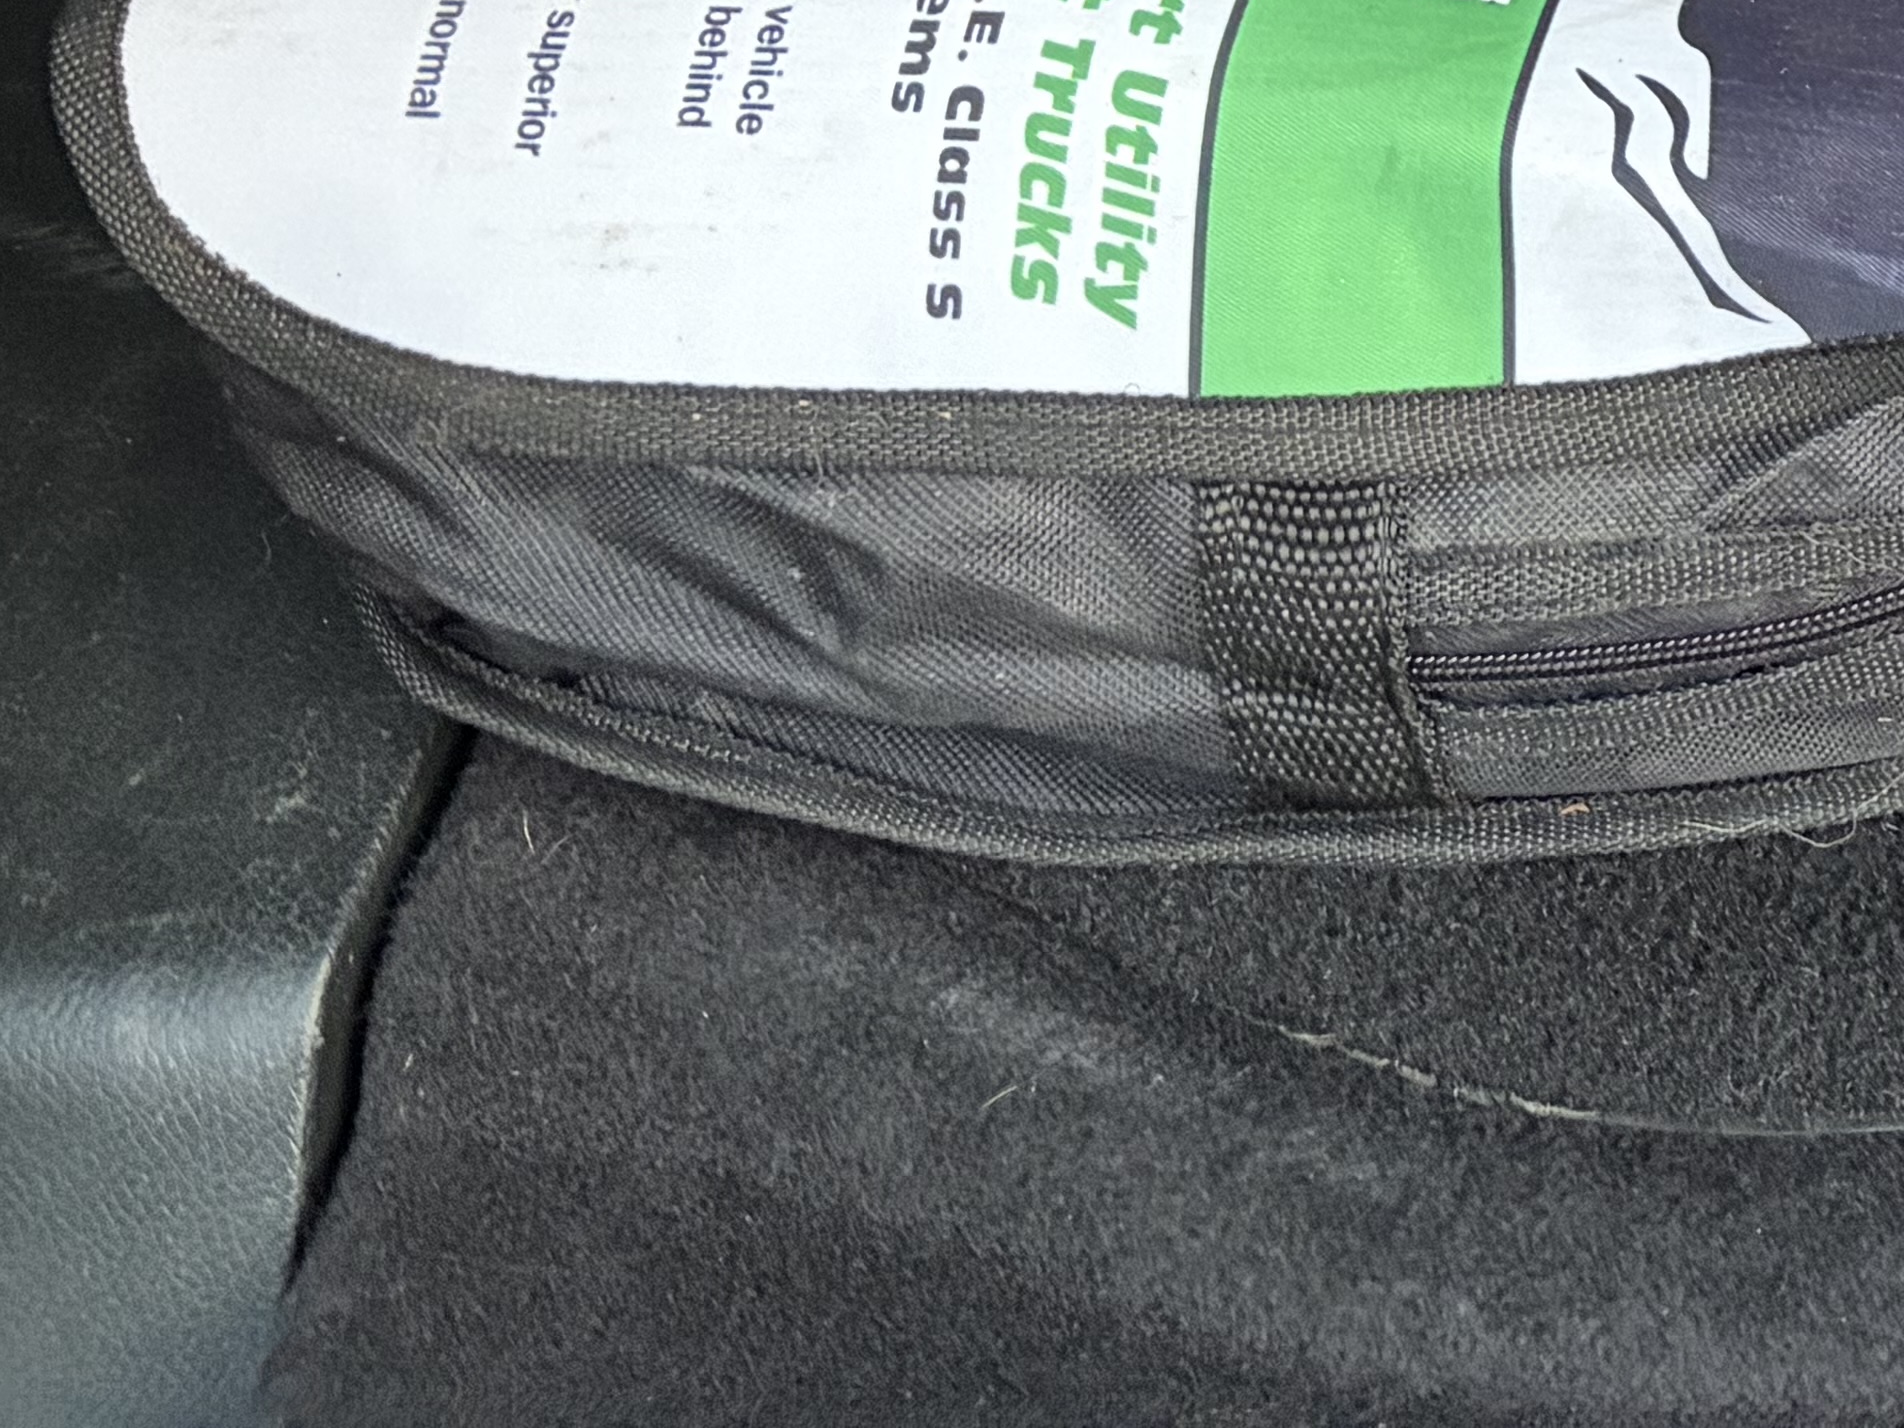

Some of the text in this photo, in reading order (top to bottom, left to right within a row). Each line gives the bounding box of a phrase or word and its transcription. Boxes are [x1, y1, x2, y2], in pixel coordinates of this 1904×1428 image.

[514, 9, 575, 156] superior
[676, 5, 743, 127] behind
[735, 5, 792, 135] vehicle
[928, 84, 985, 259] Class
[1009, 38, 1096, 305] Trucks
[1083, 69, 1168, 330] Utility
[925, 283, 962, 320] S
